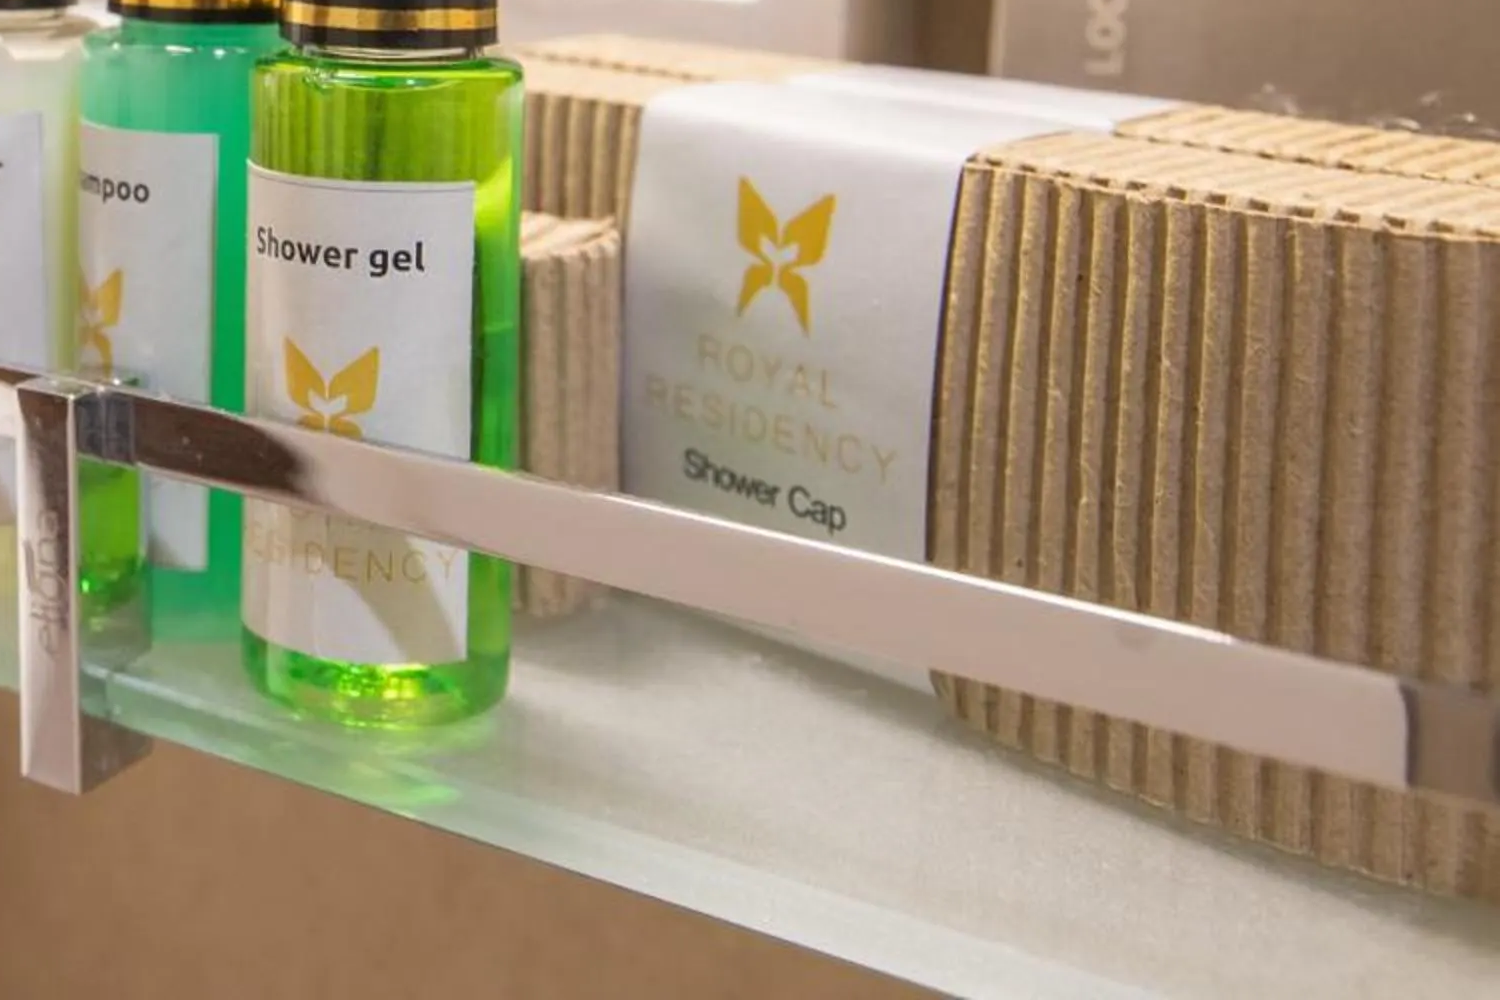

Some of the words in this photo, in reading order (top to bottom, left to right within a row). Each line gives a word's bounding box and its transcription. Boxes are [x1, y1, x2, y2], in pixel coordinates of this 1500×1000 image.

[256, 226, 359, 271] Shower
[368, 242, 425, 279] gel
[696, 332, 838, 411] ROYAL
[644, 372, 898, 485] RESIDENCY
[683, 447, 781, 508] Shower
[787, 485, 847, 535] Cap
